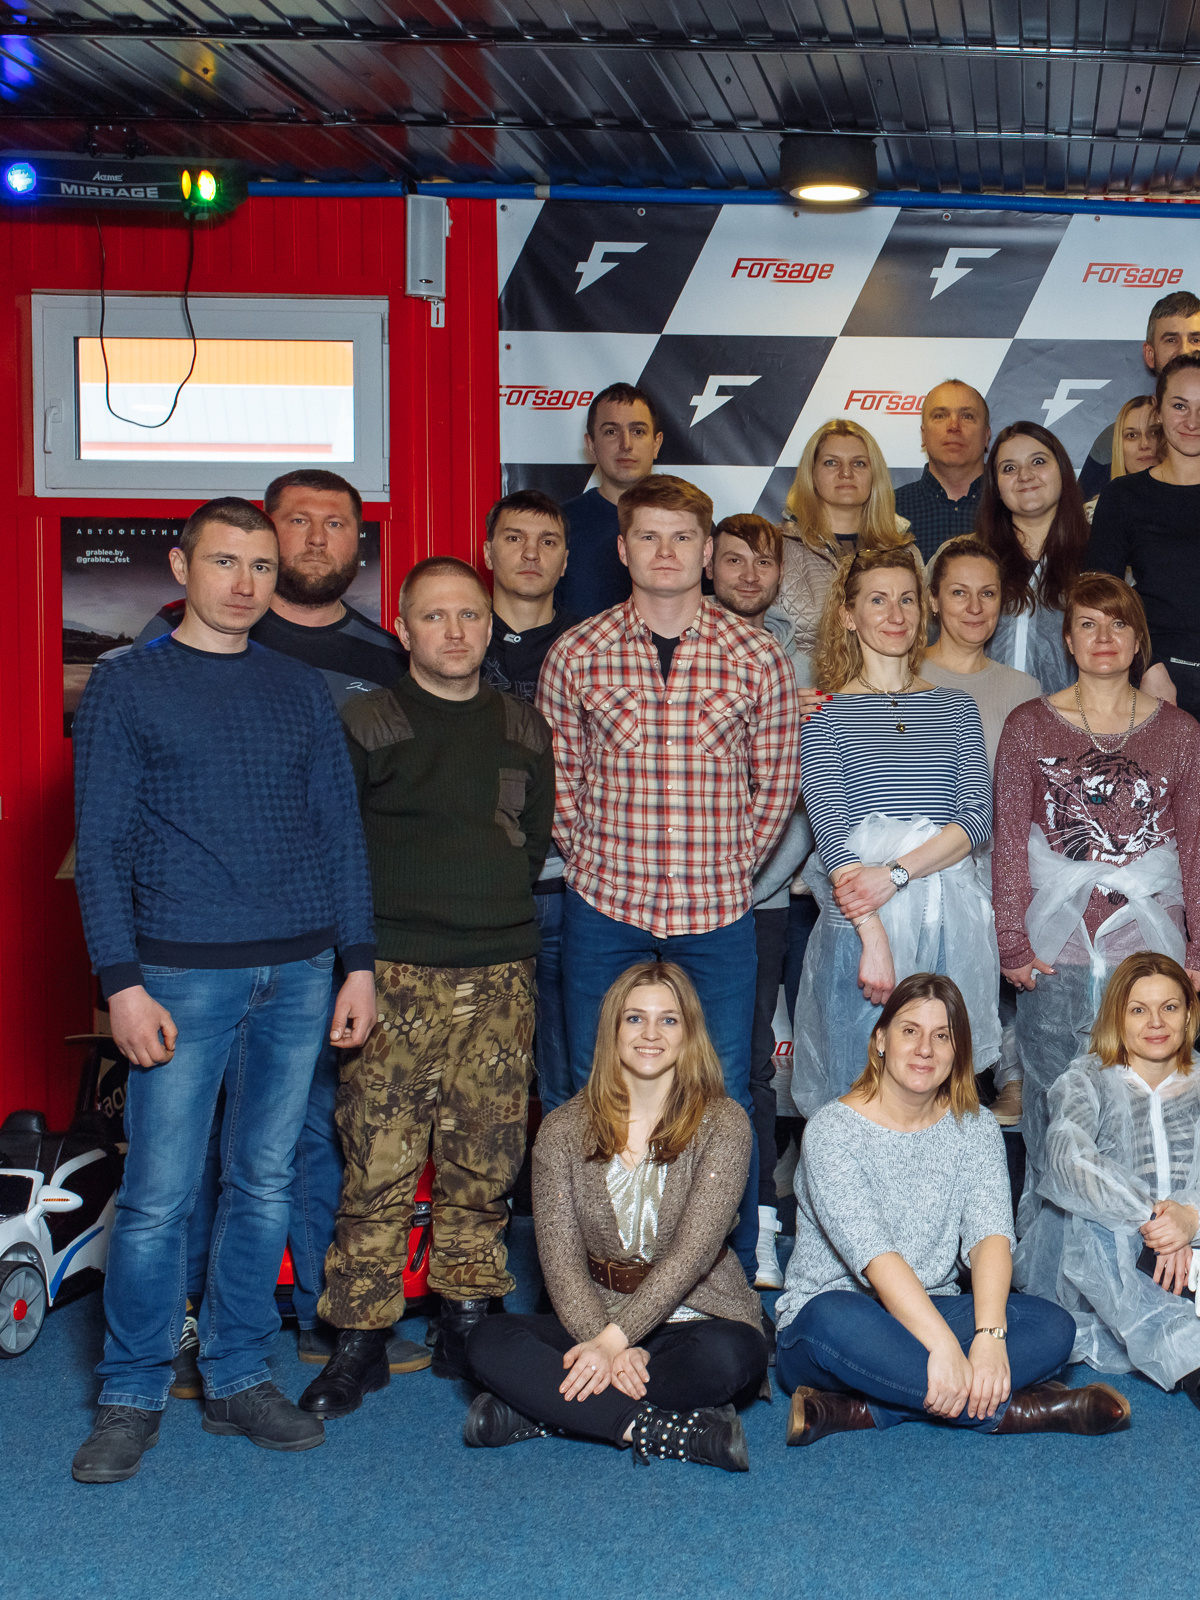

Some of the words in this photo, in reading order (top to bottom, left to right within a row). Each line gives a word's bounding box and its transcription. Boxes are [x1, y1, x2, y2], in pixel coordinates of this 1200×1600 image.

[60, 183, 159, 198] MIRRAGE
[731, 257, 835, 284] Forsage
[1082, 262, 1184, 289] Forsage
[76, 528, 179, 536] АВТОФЕСТИВ
